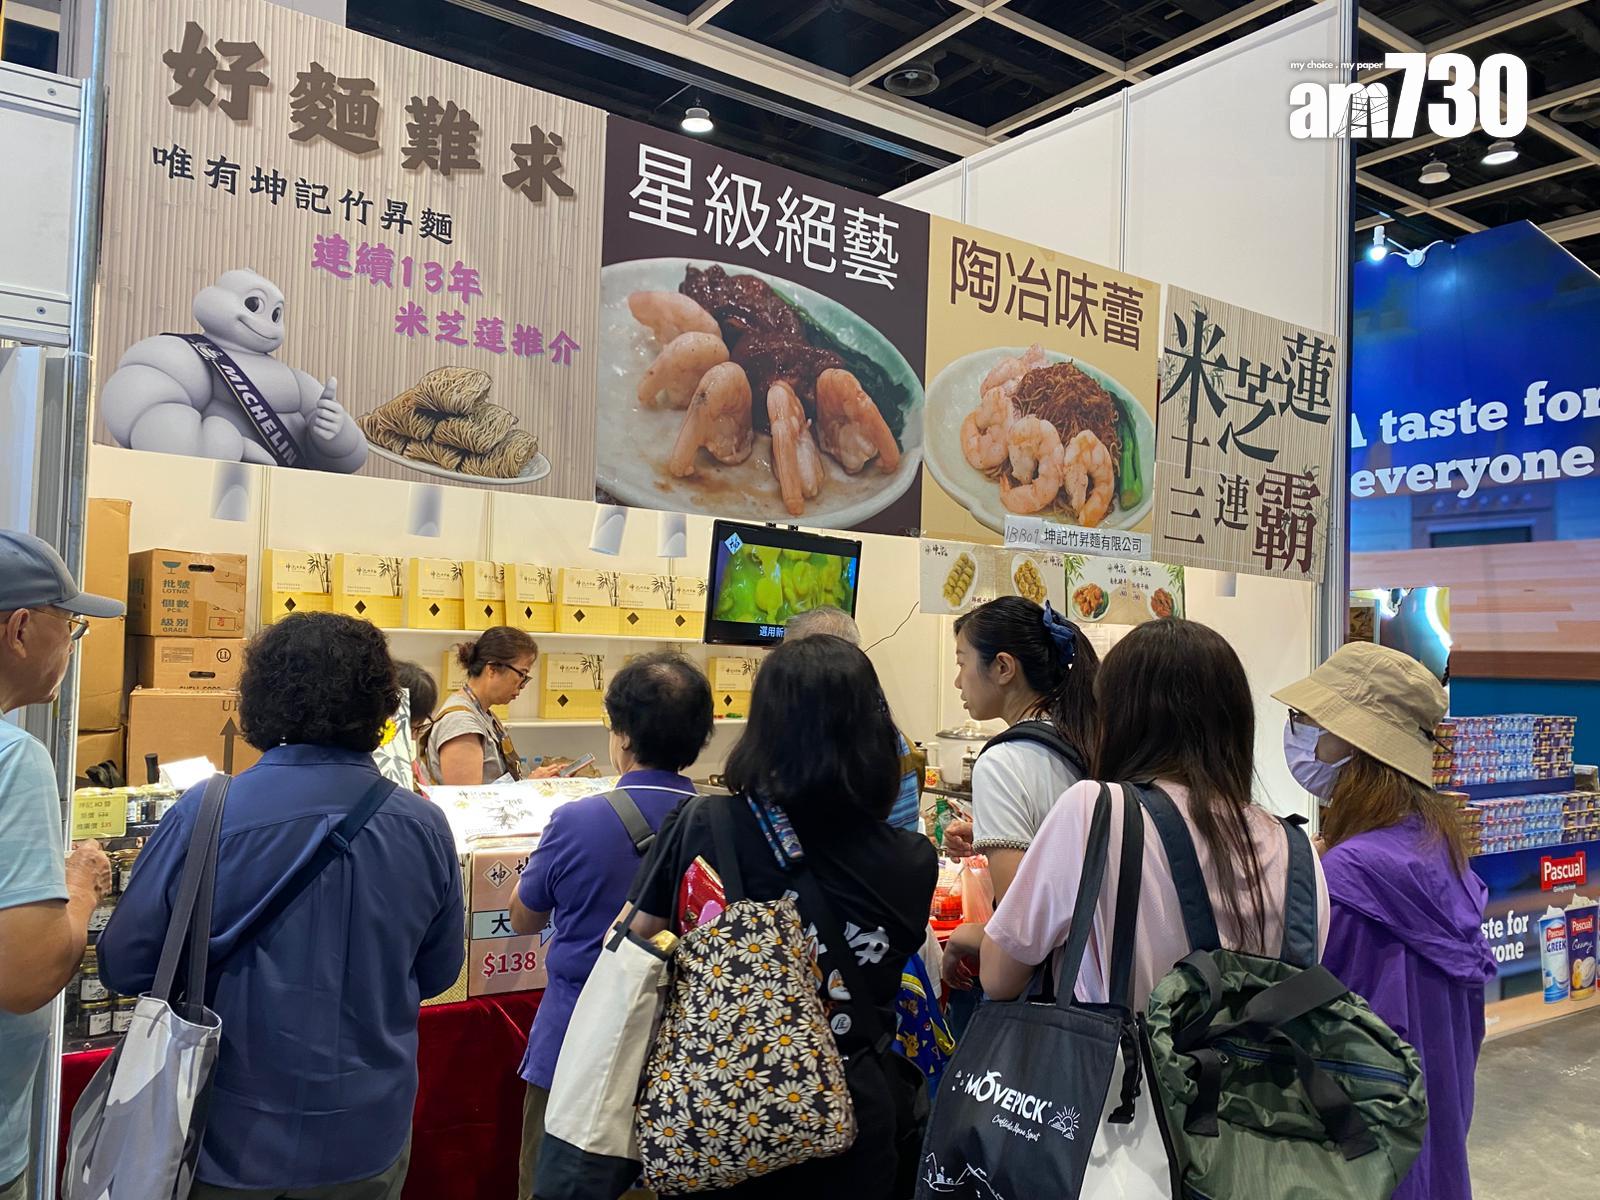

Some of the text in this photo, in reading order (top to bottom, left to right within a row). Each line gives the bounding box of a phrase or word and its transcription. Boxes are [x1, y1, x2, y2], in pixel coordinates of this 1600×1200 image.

[162, 21, 575, 203] 好麵難求
[152, 144, 453, 245] 唯有坤記竹昇麵
[629, 143, 900, 290] 星級絕藝
[311, 234, 483, 304] 連續13年
[949, 236, 1144, 351] 陶冶味蕾
[395, 301, 582, 366] 米芝蓮推介
[220, 364, 297, 467] MICHELIN
[1160, 309, 1336, 463] 米芝蓮
[1380, 398, 1508, 445] taste
[1524, 381, 1600, 426] for
[1351, 445, 1595, 499] everyone
[1044, 528, 1142, 553] 坤記竹昇麵有限公司
[1544, 857, 1583, 881] Pascual
[1480, 910, 1529, 940] ste for
[482, 952, 537, 978] $138
